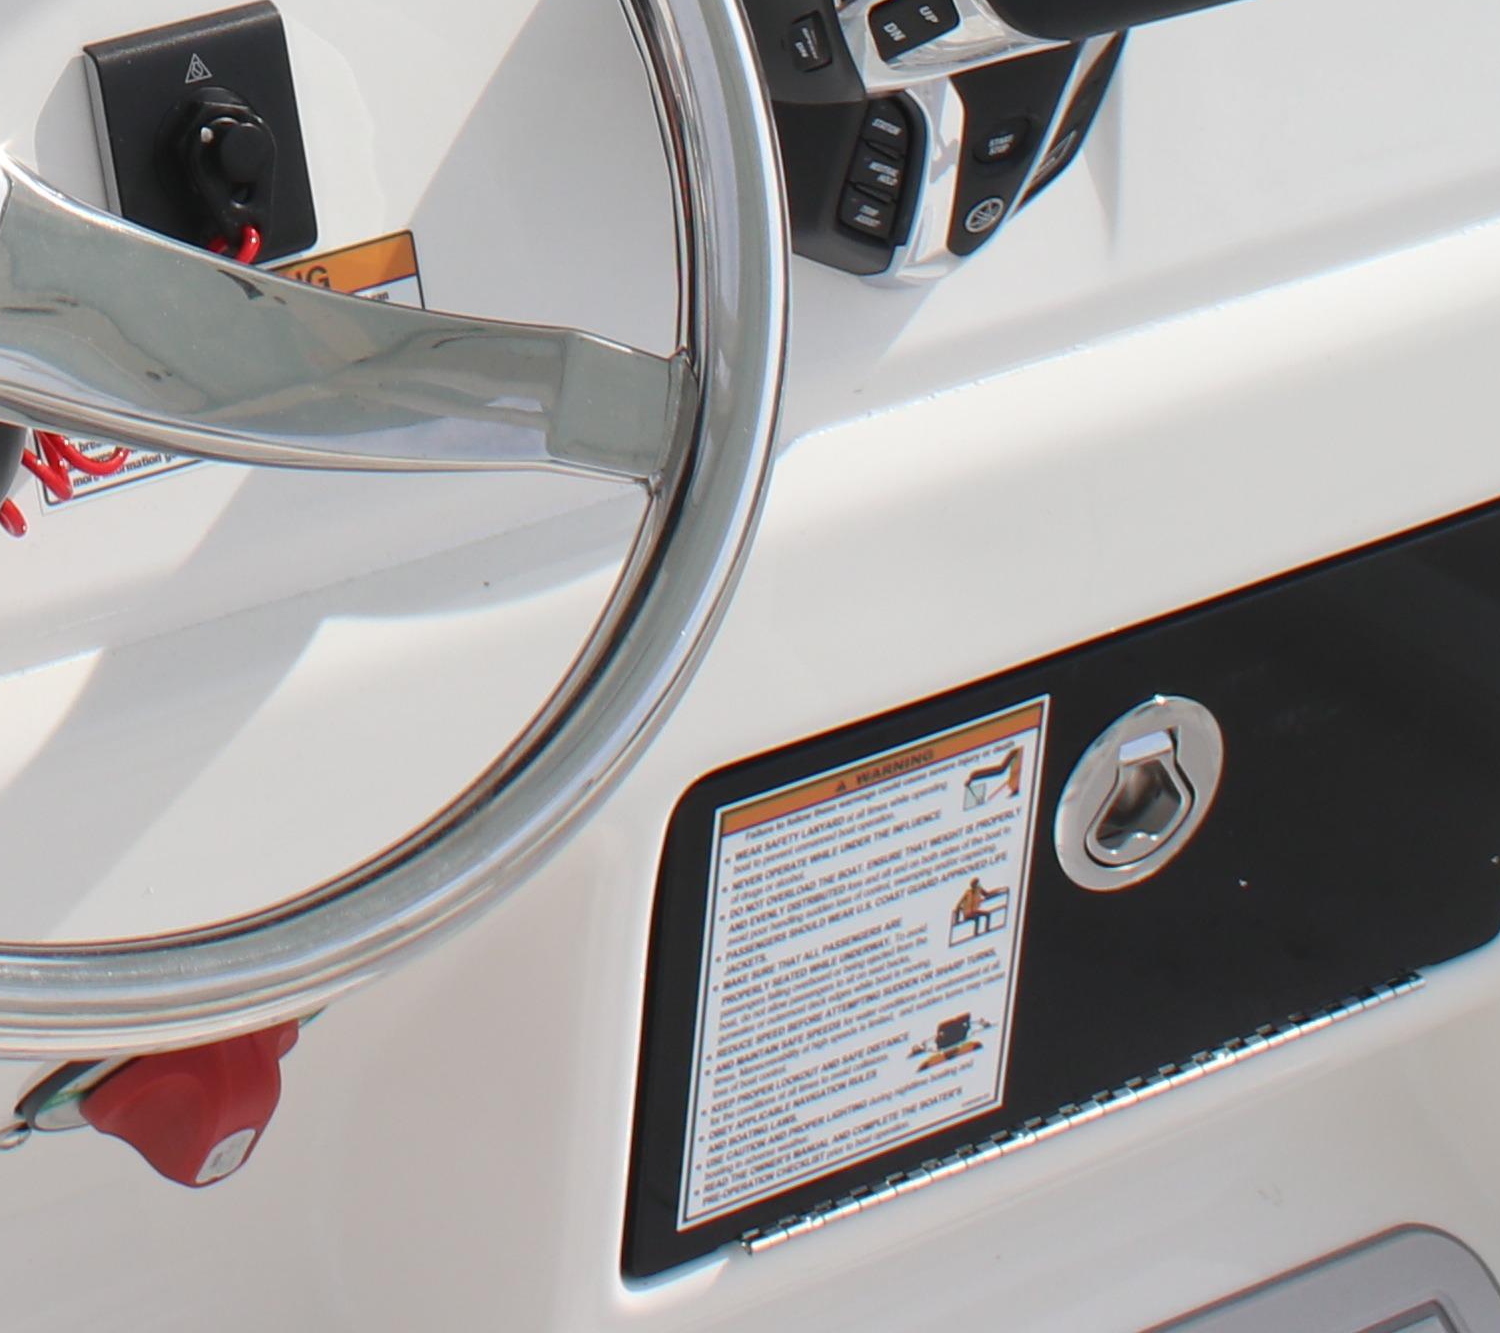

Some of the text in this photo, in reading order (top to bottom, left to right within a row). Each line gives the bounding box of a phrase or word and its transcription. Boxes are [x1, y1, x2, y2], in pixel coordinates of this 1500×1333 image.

[883, 22, 906, 42] DN
[919, 5, 939, 23] UP
[855, 747, 934, 786] WARNING
[731, 808, 940, 893] NEVER OPERATE WHILE UNDER THE INFLUENCE
[734, 814, 845, 865] WEAR SAFETY LANYARD
[711, 1031, 908, 1114] KEEP PROPER LOOKOUT AND SAFE DISTANCE
